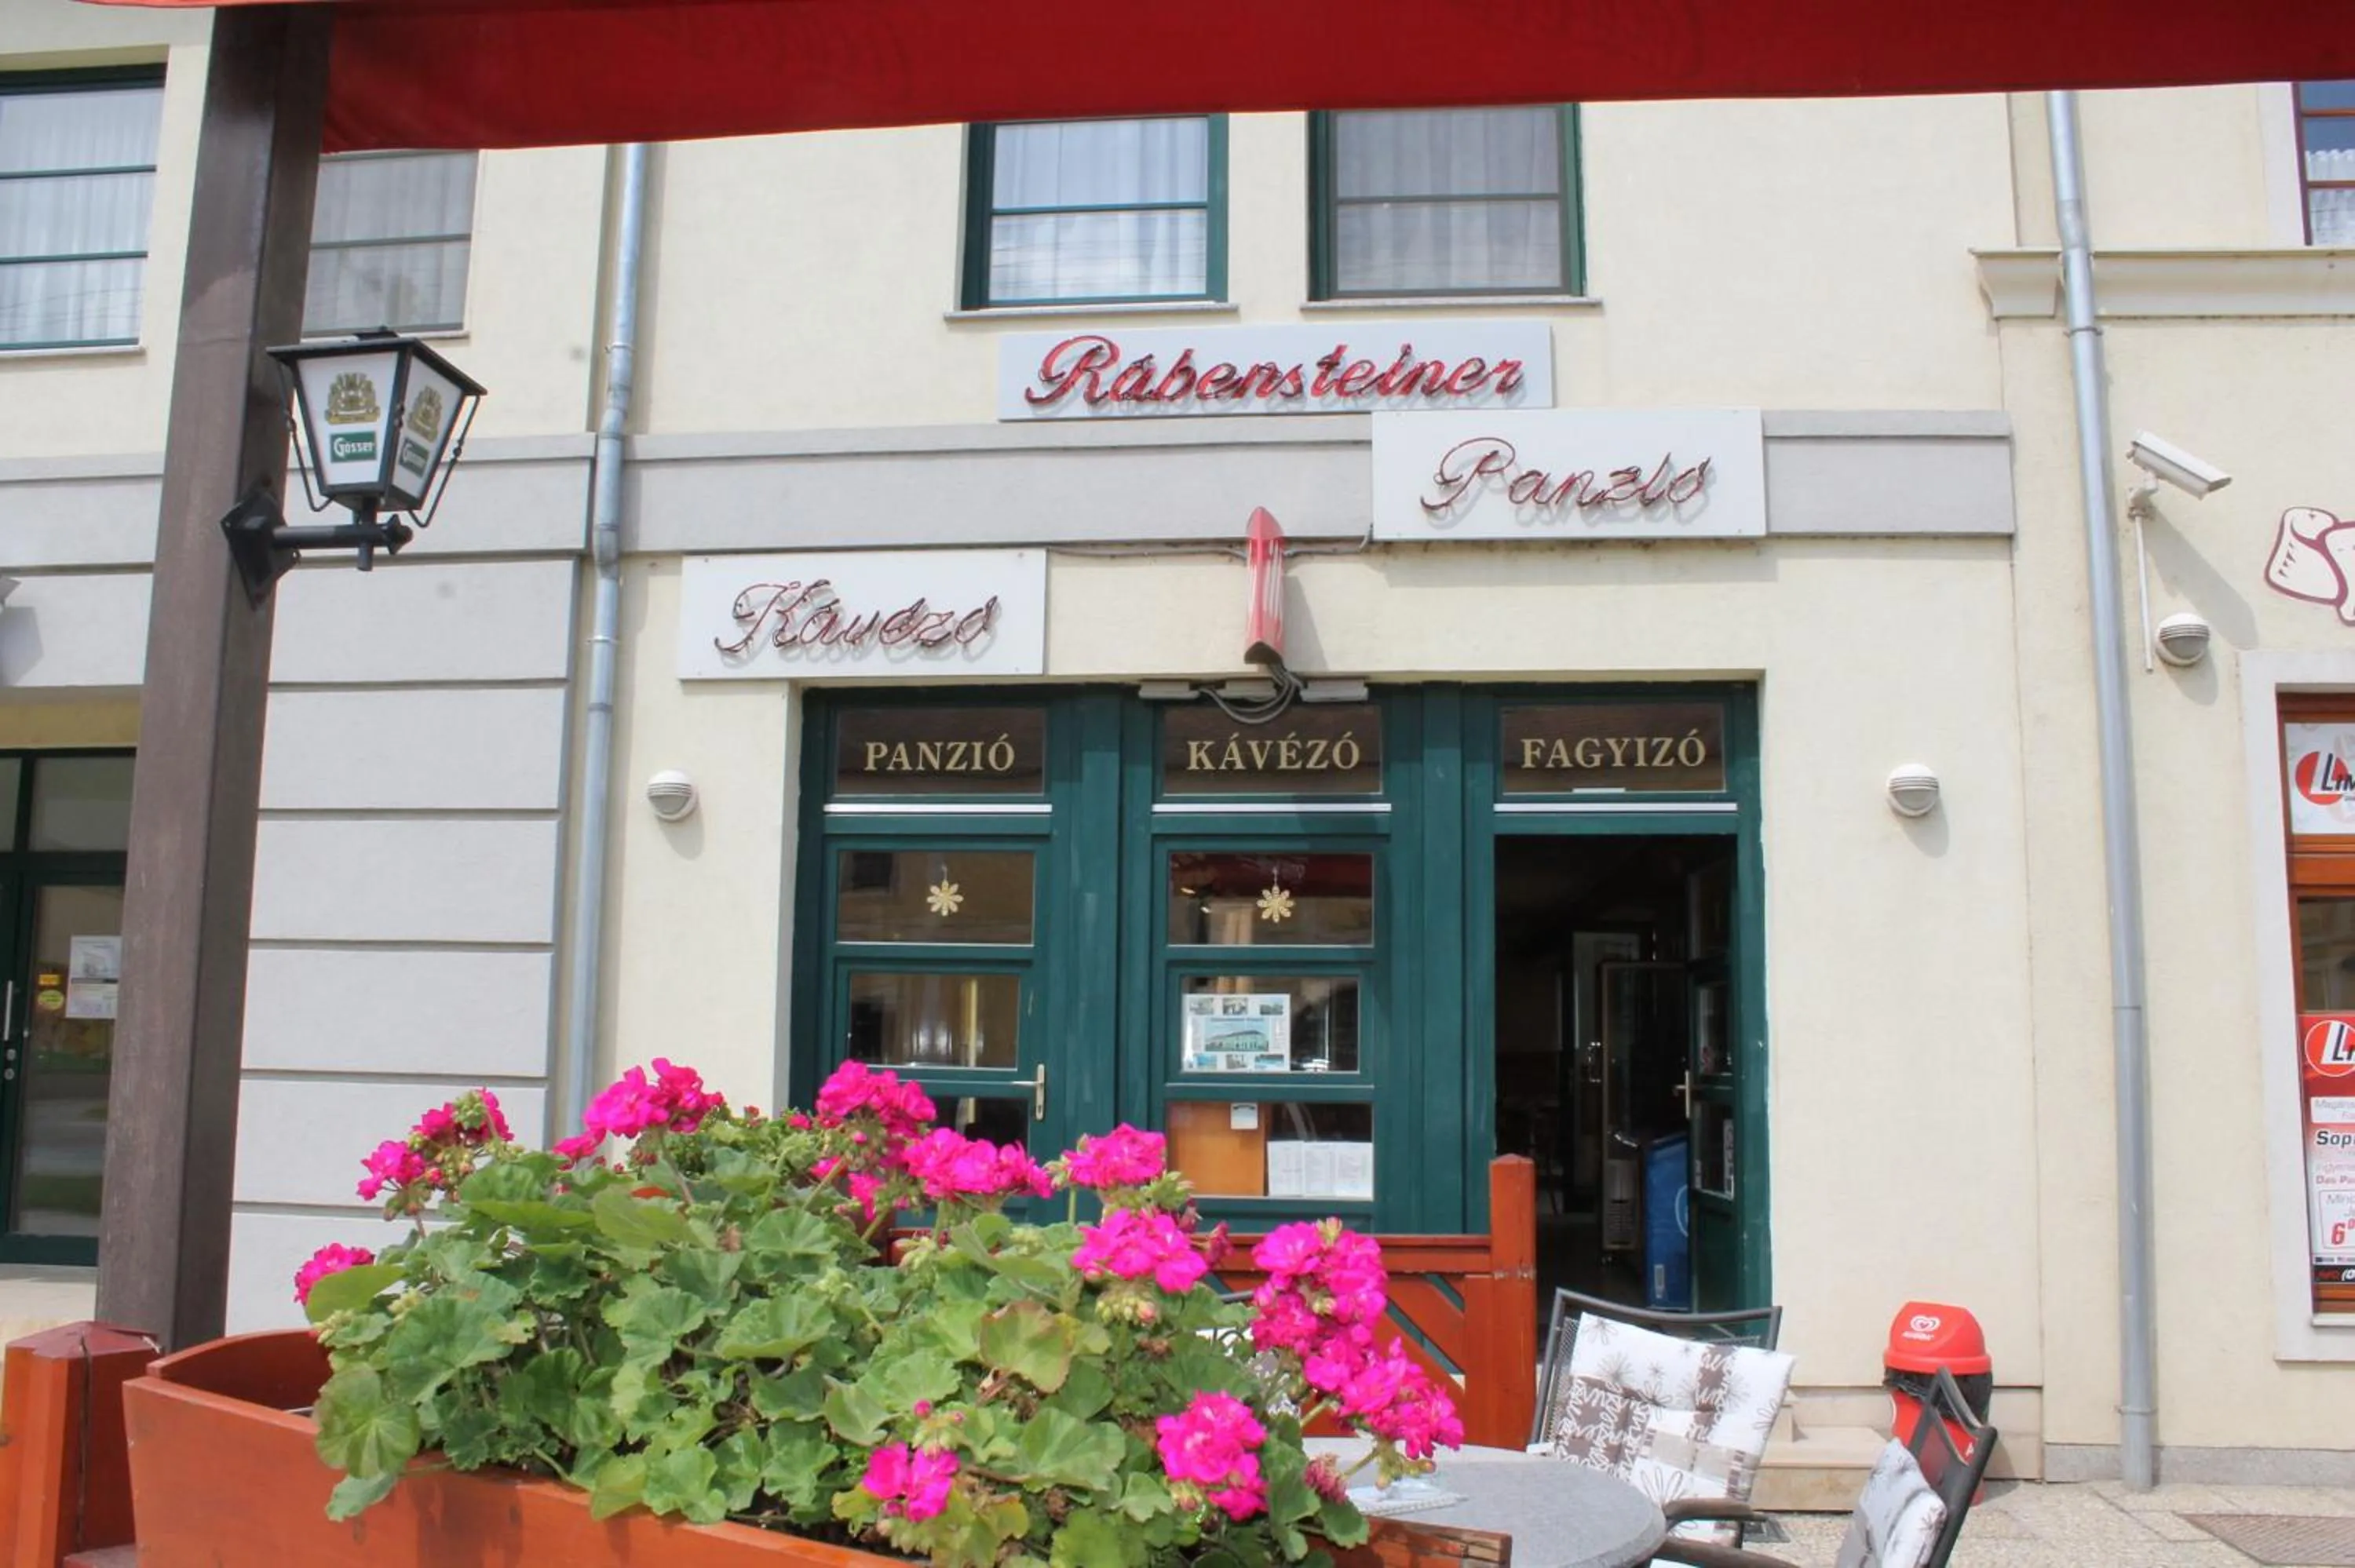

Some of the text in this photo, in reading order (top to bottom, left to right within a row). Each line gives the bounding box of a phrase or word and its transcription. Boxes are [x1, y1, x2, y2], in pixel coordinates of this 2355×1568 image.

[864, 733, 1015, 772] PANZIÓ
[1185, 730, 1360, 770] KÁVÉZÓ
[1521, 728, 1707, 768] FAGYIZÓ
[2317, 1131, 2355, 1150] Sop
